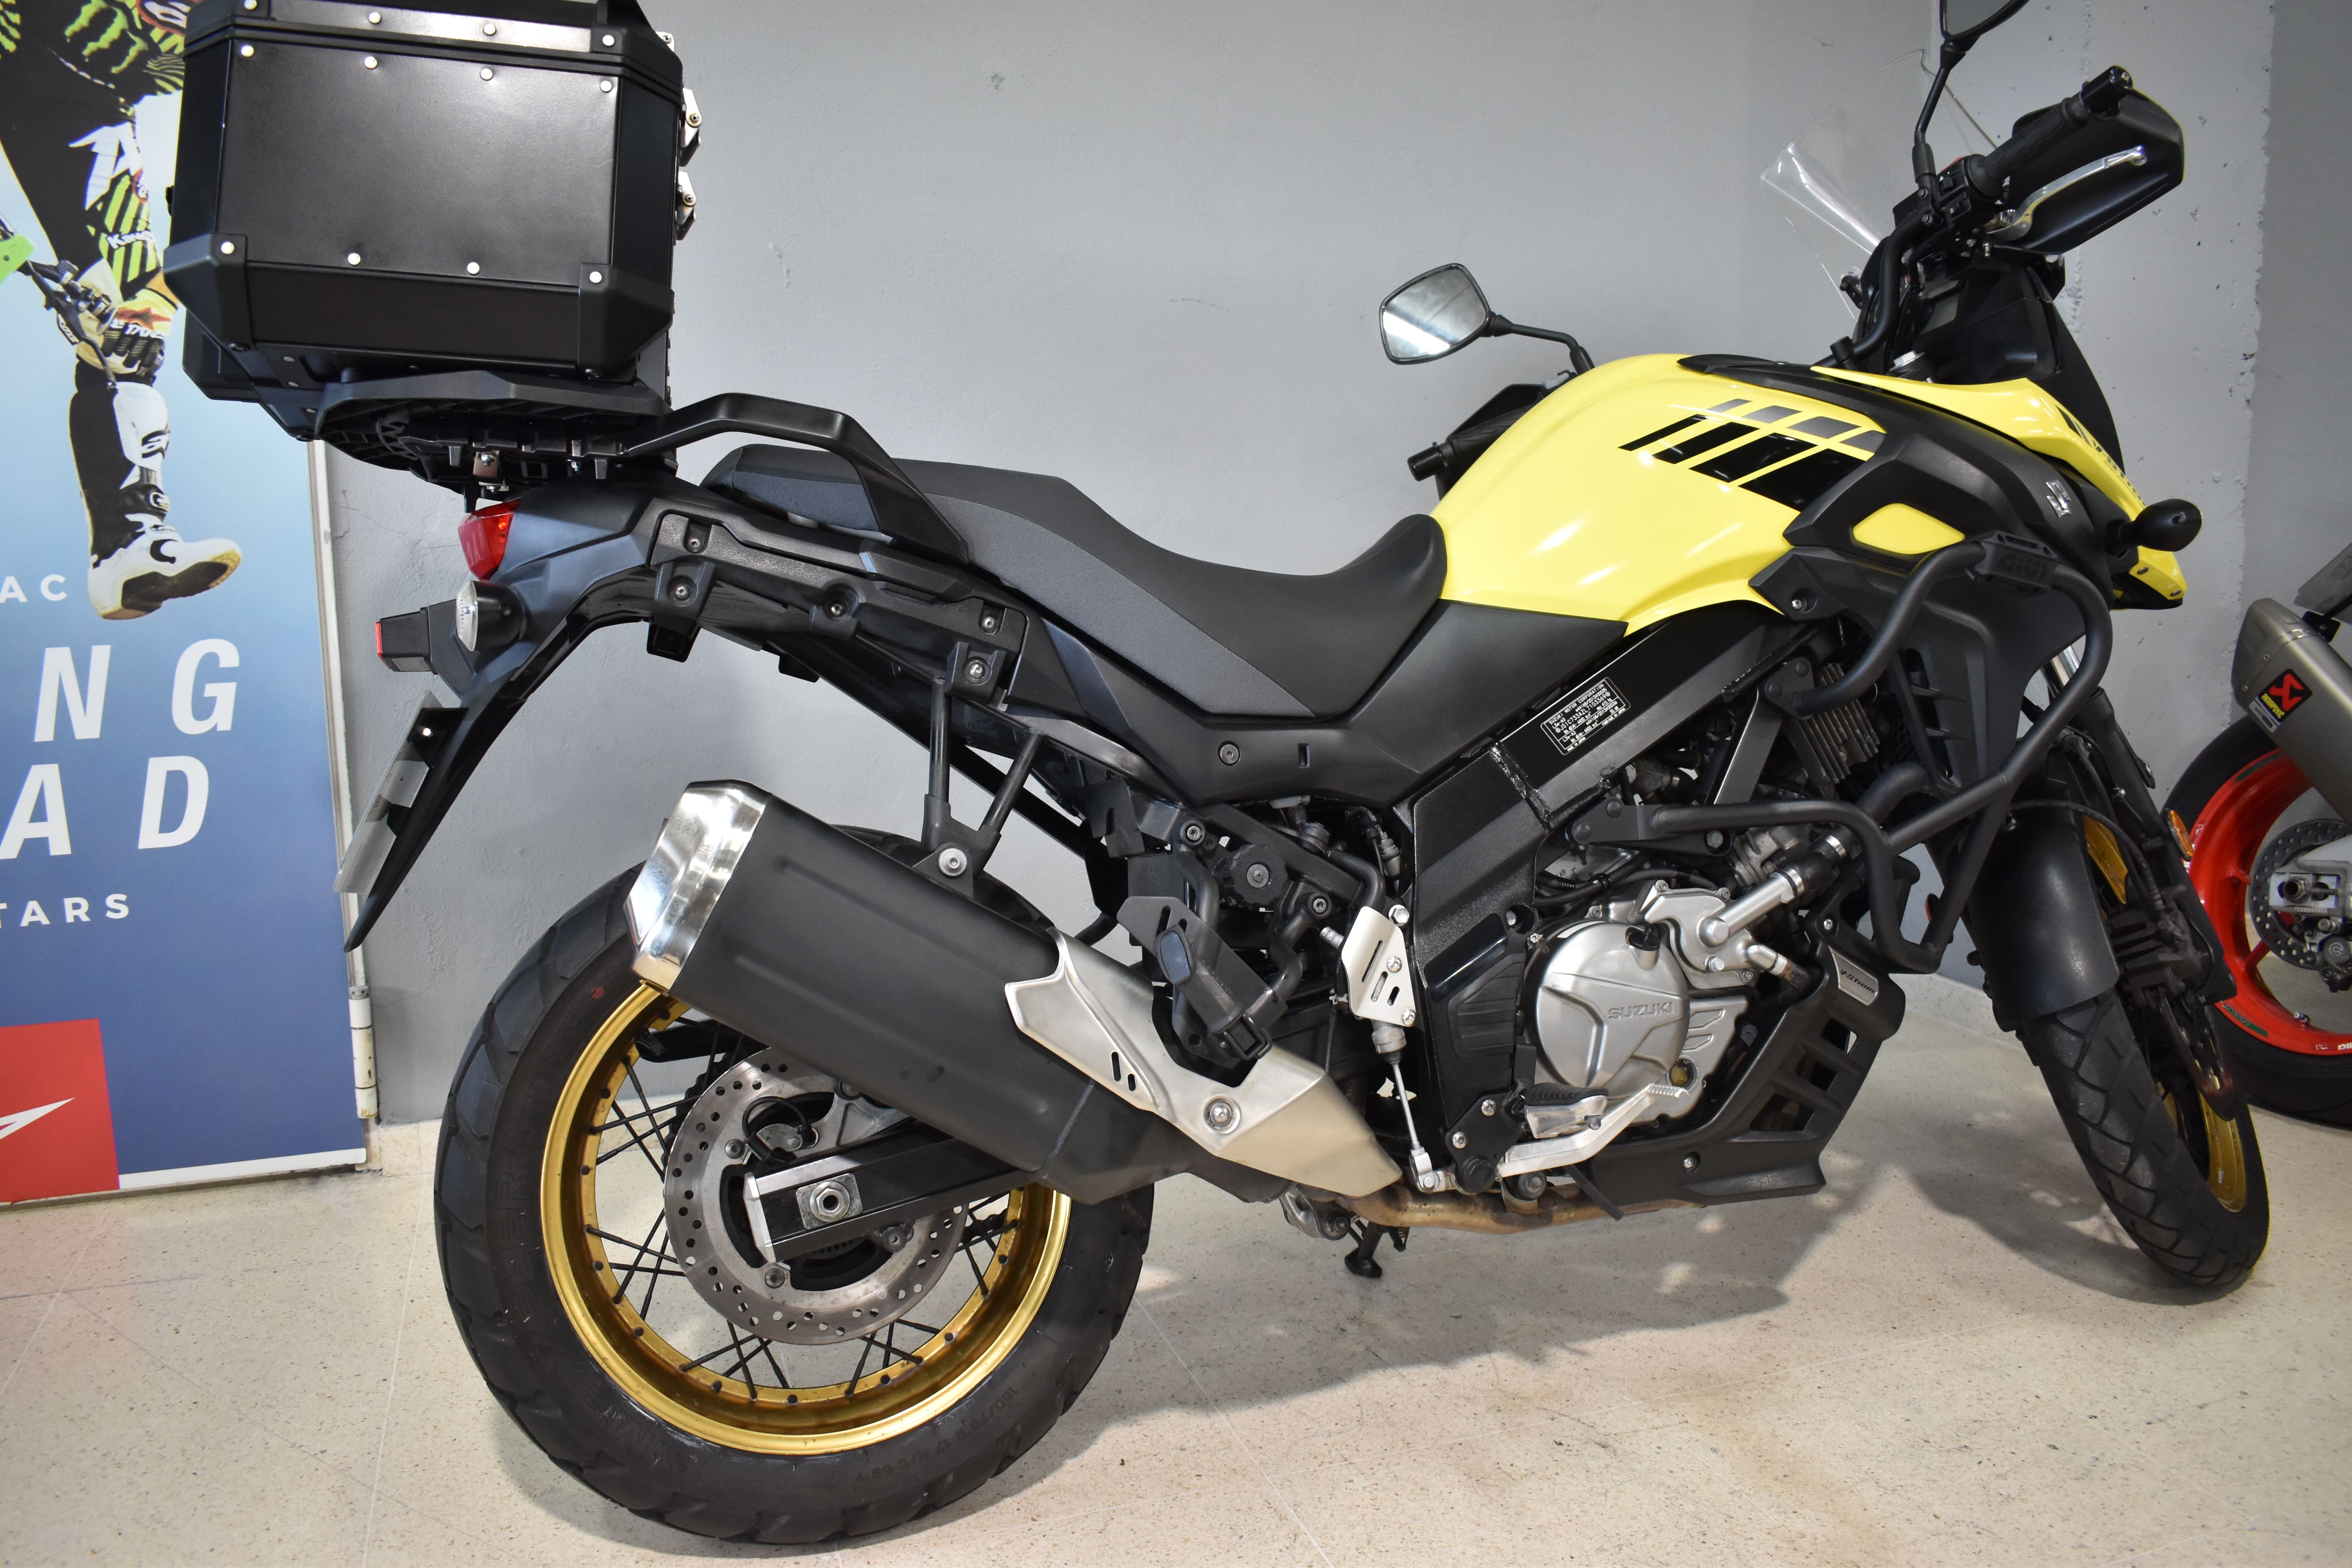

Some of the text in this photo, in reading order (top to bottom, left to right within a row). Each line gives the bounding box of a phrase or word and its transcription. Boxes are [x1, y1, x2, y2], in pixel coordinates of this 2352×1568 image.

[1548, 683, 1604, 725] SUZUKI MOTOR CORPORATION
[1608, 1002, 1673, 1020] SUZUKI
